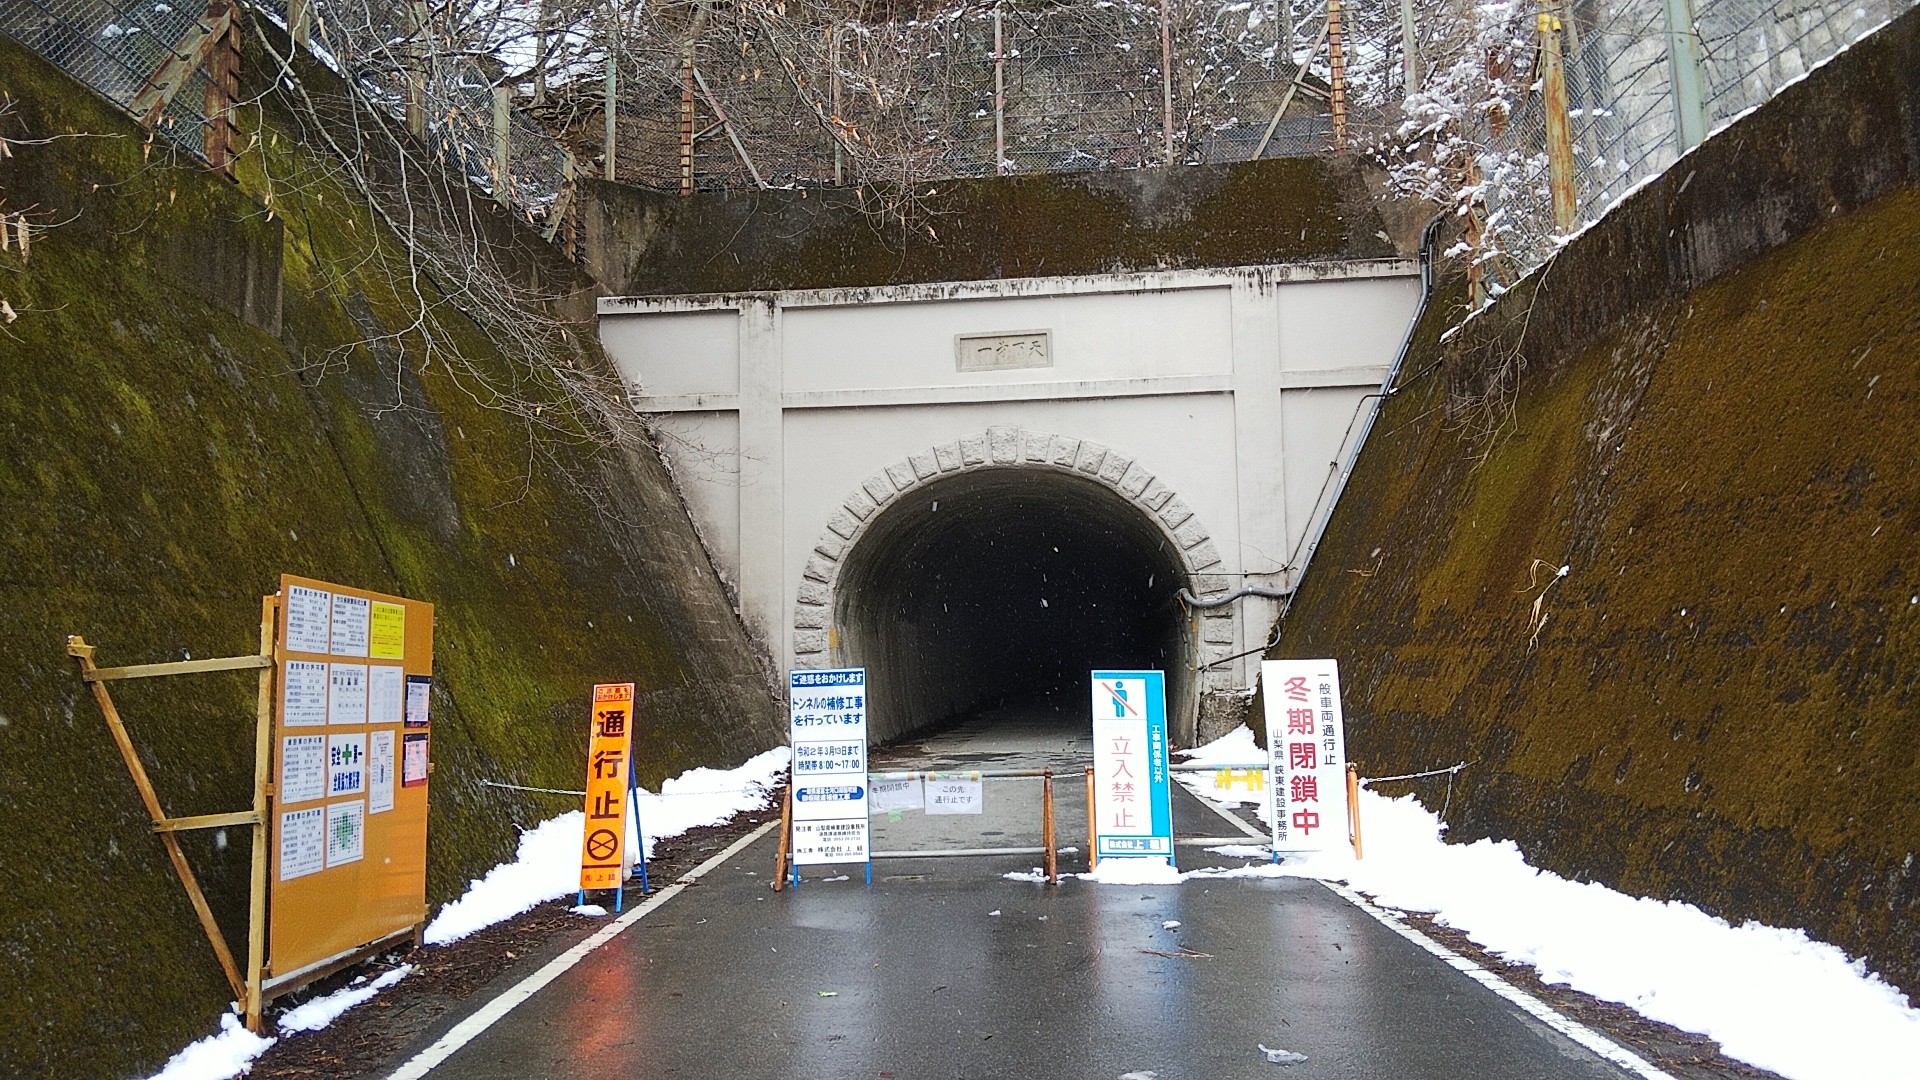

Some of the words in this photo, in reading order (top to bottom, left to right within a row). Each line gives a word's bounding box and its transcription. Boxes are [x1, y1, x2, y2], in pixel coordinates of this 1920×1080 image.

[792, 673, 863, 685] ご迷惑をおかけします
[792, 695, 863, 711] トンネルの補修工事
[794, 713, 863, 726] を行っています
[1317, 673, 1337, 765] 一般車両通行止
[590, 710, 625, 820] 通行止
[1151, 725, 1163, 784] 工事関係者以外
[1283, 676, 1320, 836] 冬期閉鎖中
[934, 795, 973, 804] 通行止です
[942, 785, 965, 794] この先
[1111, 735, 1137, 828] 立入禁止
